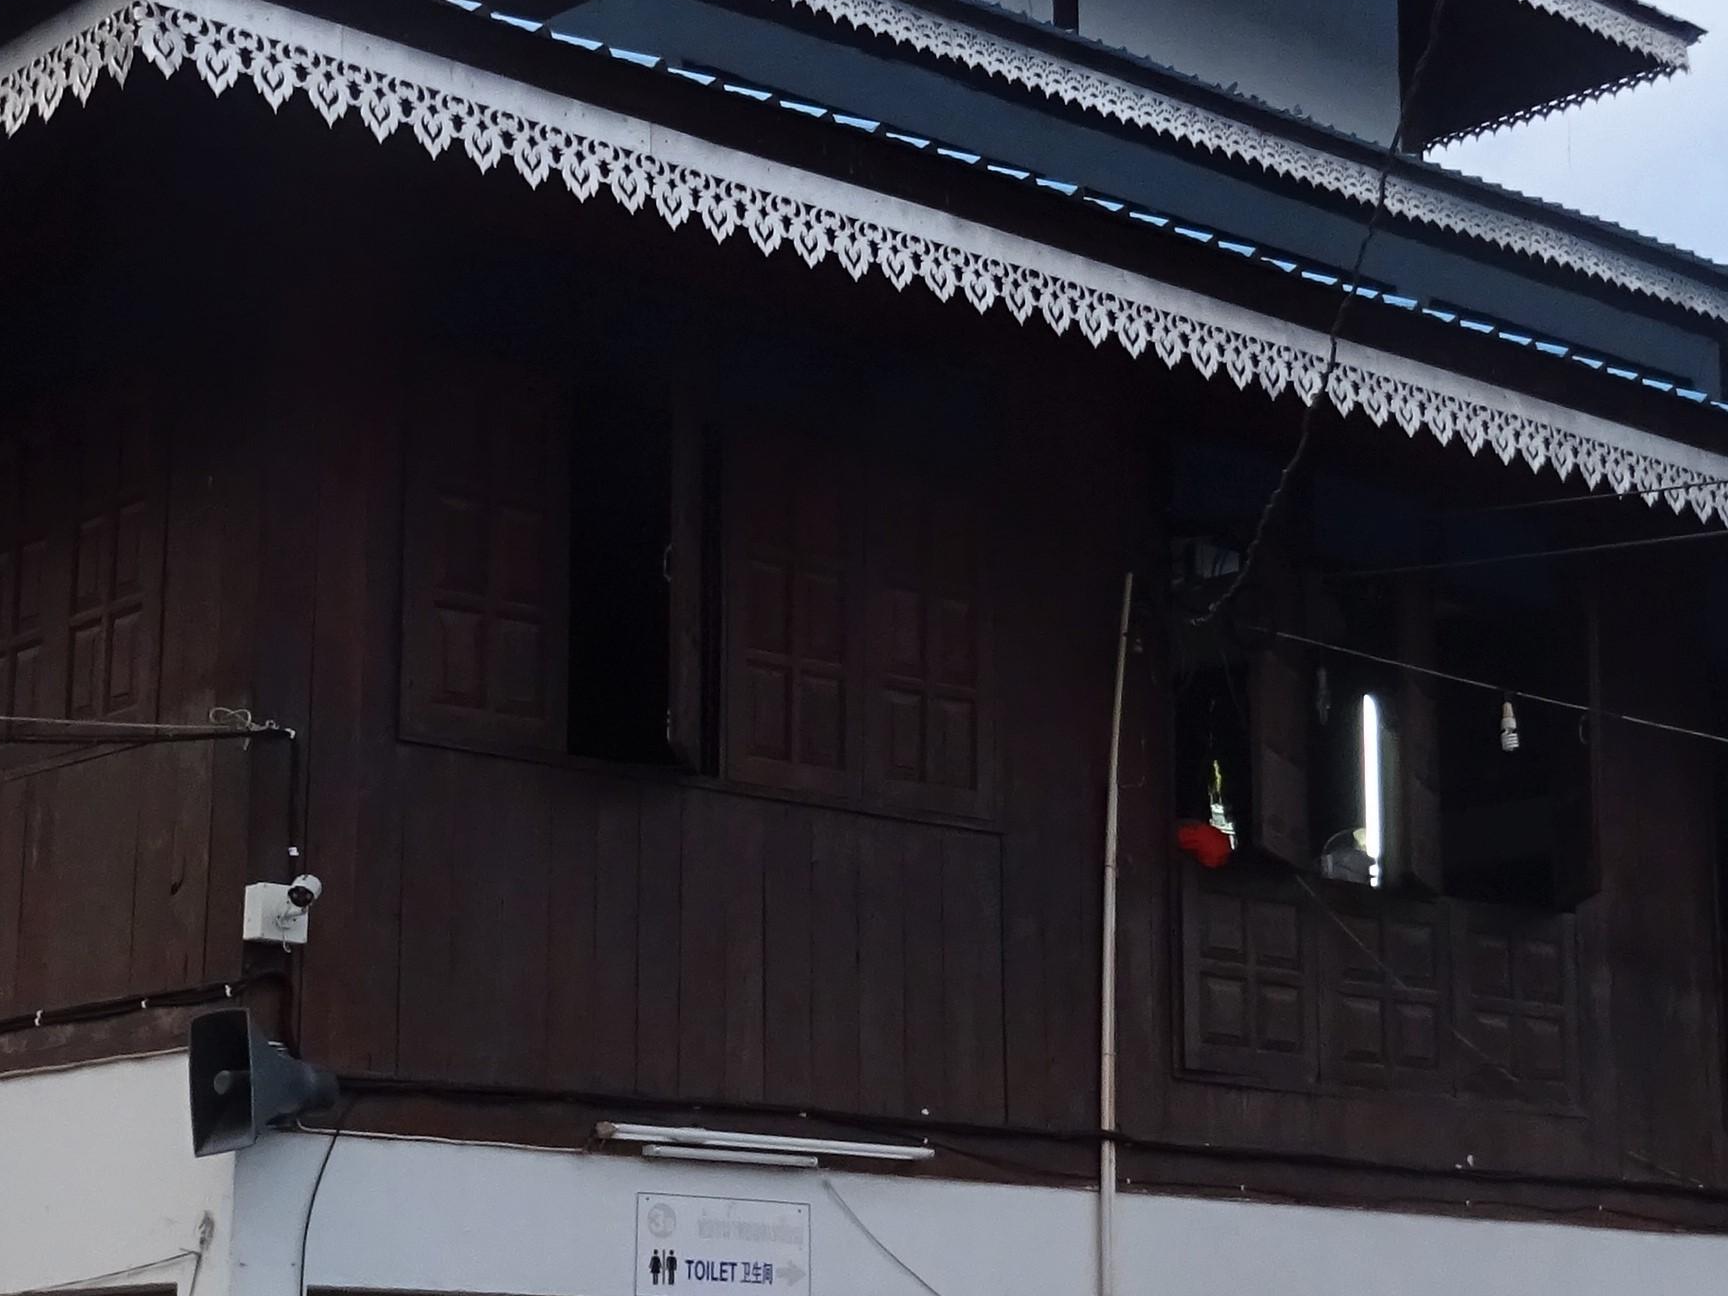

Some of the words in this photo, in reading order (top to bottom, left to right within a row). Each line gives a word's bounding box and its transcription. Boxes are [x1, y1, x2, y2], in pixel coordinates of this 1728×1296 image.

[685, 1259, 738, 1283] TOILET
[740, 1261, 774, 1286] 卫生间
